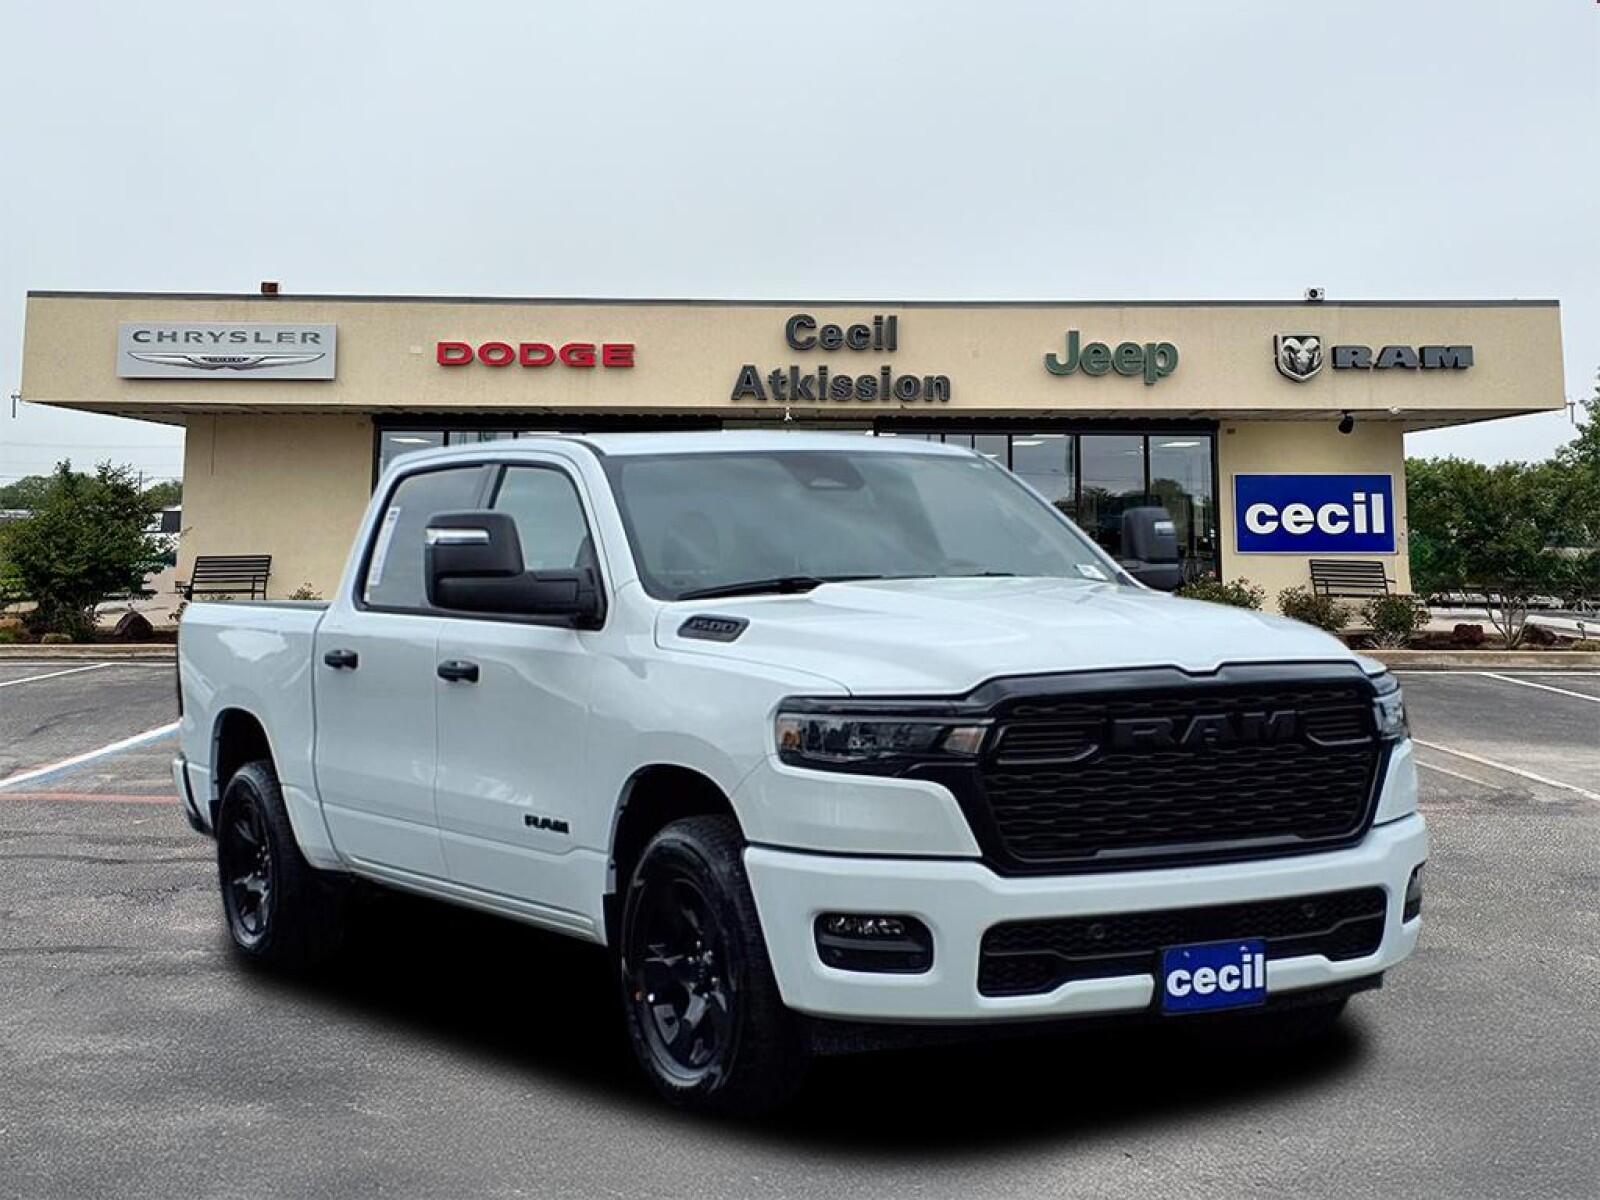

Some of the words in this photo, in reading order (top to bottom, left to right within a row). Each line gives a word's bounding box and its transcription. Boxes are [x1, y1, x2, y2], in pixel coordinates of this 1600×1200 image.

[132, 330, 321, 345] CHRYSLER
[785, 313, 899, 352] Cecil
[436, 341, 635, 368] DODGE
[1044, 329, 1179, 386] Jeep
[1331, 344, 1474, 370] RAM
[731, 364, 952, 402] Atkission
[1244, 491, 1386, 535] cecil
[1112, 709, 1297, 748] RAM
[525, 814, 569, 834] RAM
[1166, 953, 1265, 997] cecil
